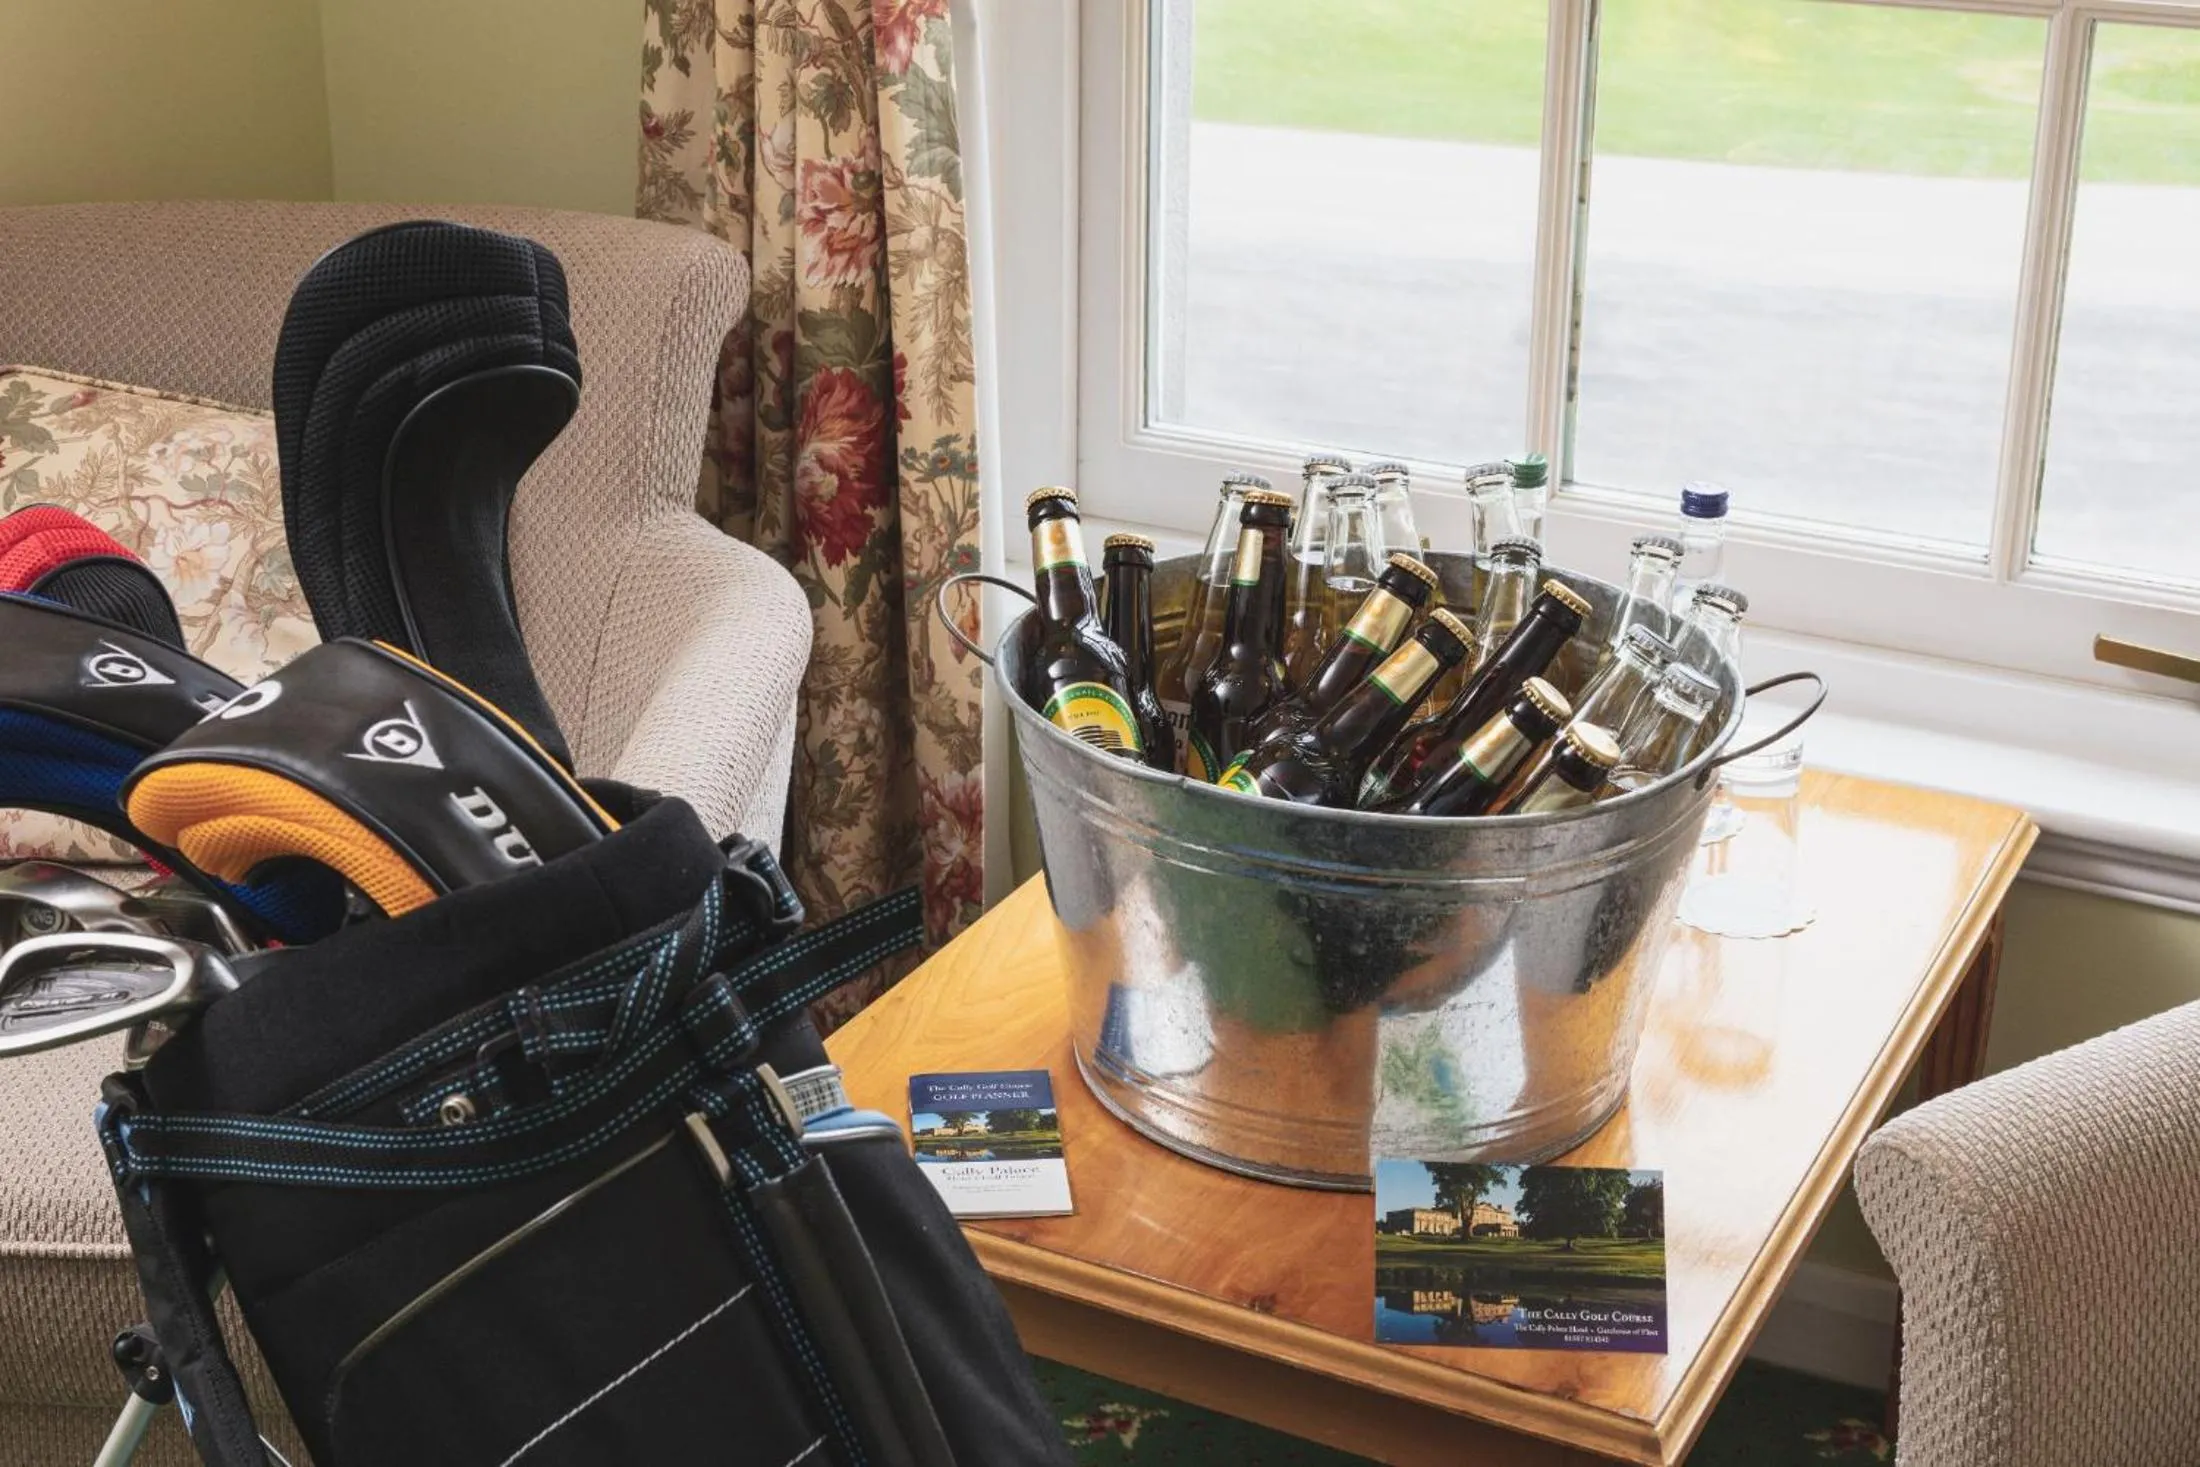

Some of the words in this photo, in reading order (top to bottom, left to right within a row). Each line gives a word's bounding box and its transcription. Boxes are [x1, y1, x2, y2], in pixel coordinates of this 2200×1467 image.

[1517, 1307, 1542, 1320] THE
[1543, 1308, 1577, 1320] CALLY
[1580, 1309, 1609, 1321] GOLF
[1612, 1311, 1654, 1323] COURSE
